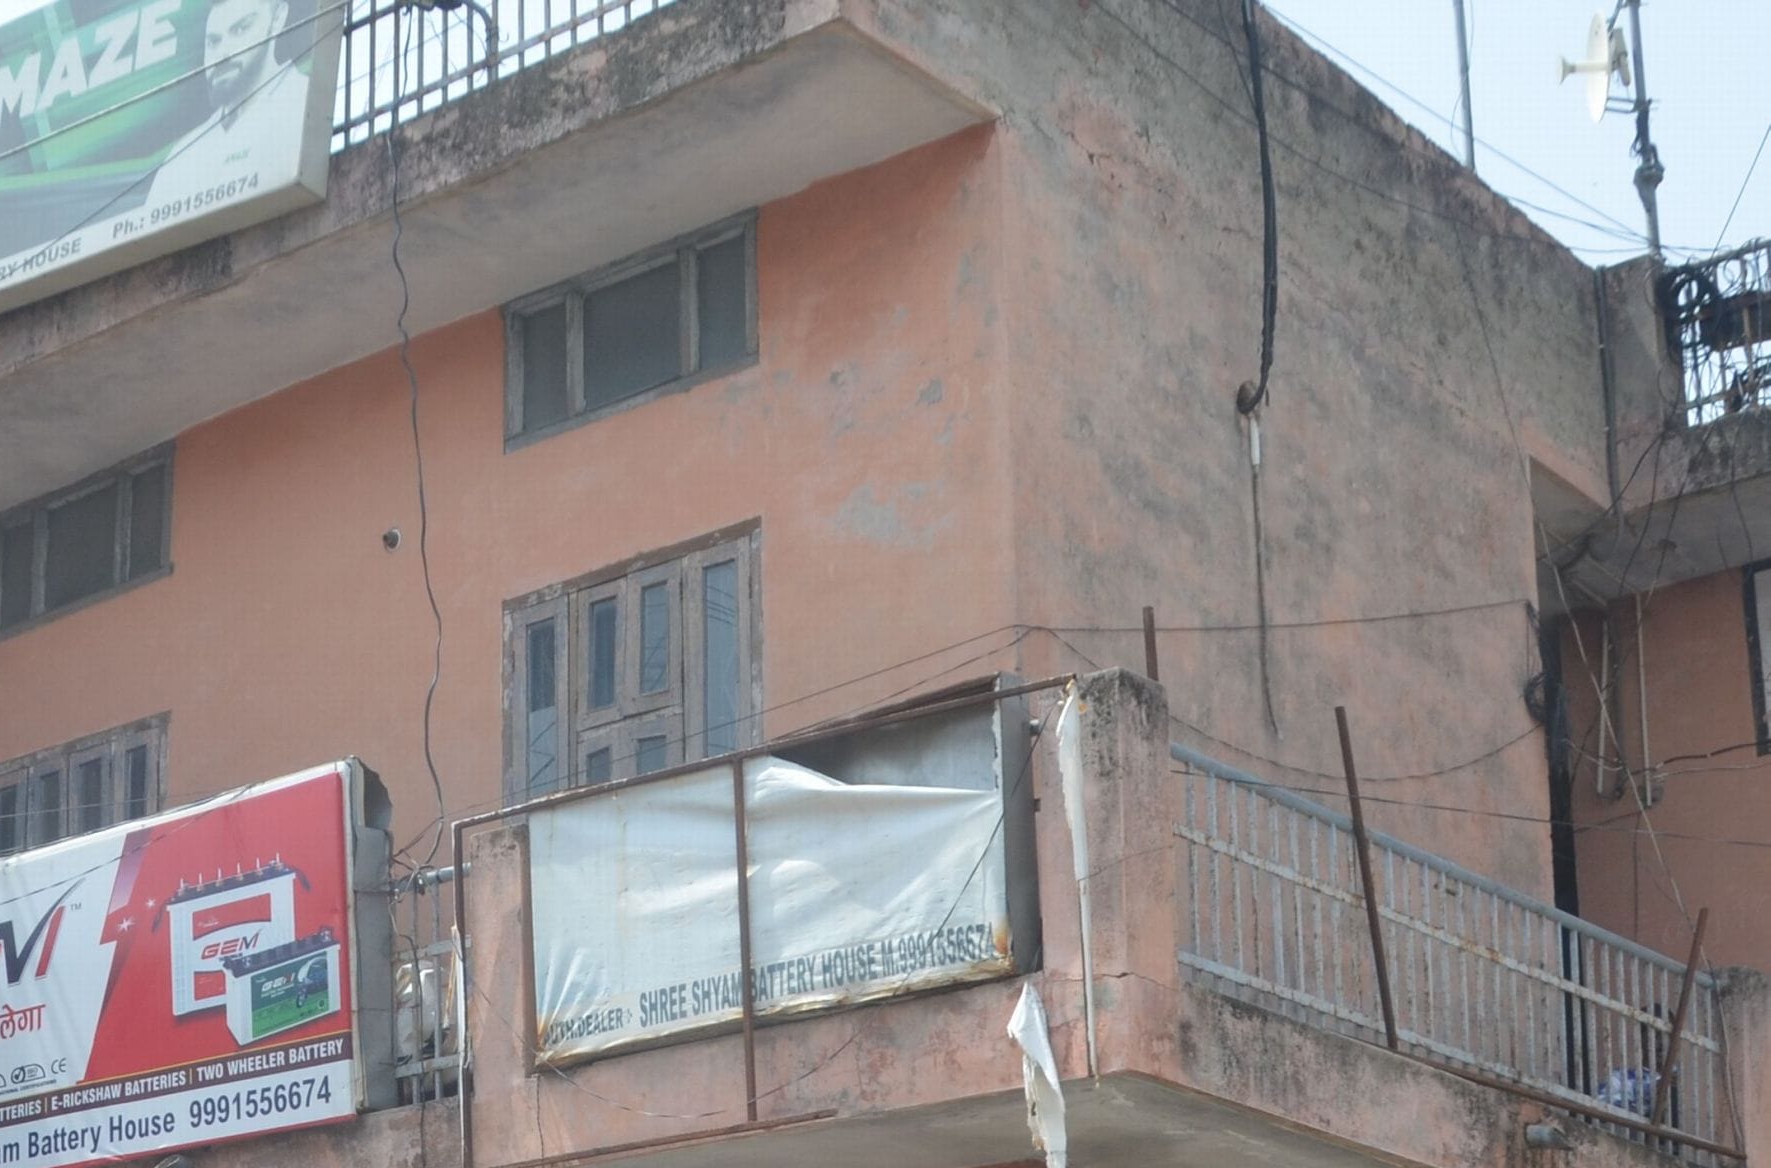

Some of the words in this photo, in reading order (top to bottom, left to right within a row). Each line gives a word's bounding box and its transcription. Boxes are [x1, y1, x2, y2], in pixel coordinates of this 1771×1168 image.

[23, 236, 82, 274] HOUSE
[150, 173, 259, 226] 9991556674
[201, 929, 261, 960] GEM
[640, 983, 687, 1028] SHREE
[692, 971, 744, 1016] SHYAM
[822, 944, 877, 989] HOUSE
[51, 1083, 122, 1111] E-RICKSHAW
[124, 1069, 187, 1097] BATTERIES
[196, 1062, 224, 1082] TWO
[227, 1051, 285, 1076] WHEELER
[289, 1038, 344, 1064] BATTERY
[28, 1124, 101, 1166] Battery
[109, 1110, 176, 1144] House
[189, 1076, 331, 1129] 9991556674
